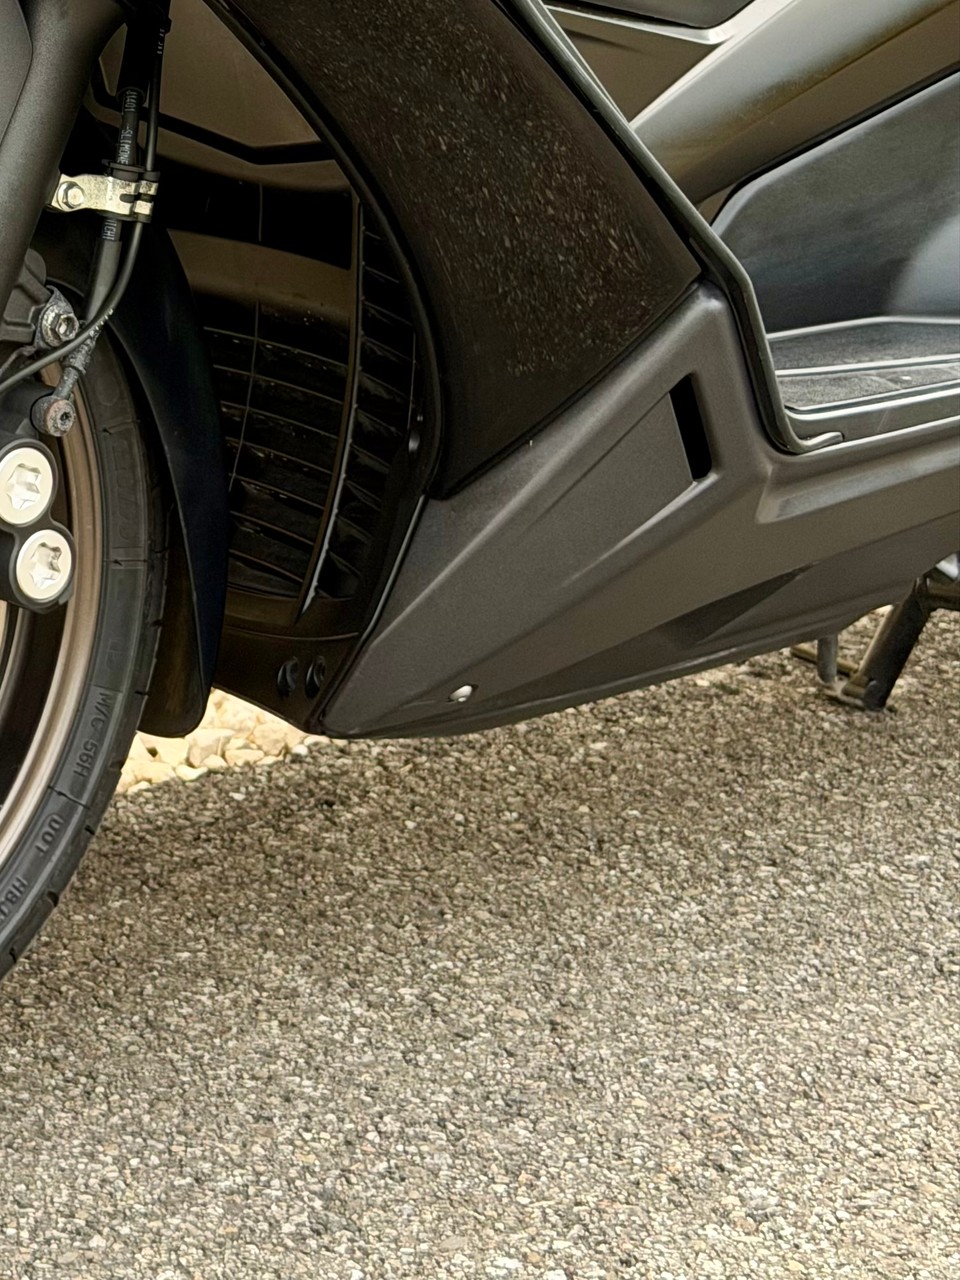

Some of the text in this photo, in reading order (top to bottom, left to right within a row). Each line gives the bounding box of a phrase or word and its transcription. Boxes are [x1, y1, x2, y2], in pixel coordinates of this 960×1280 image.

[73, 692, 111, 778] M/C 56H
[35, 815, 64, 854] DOT
